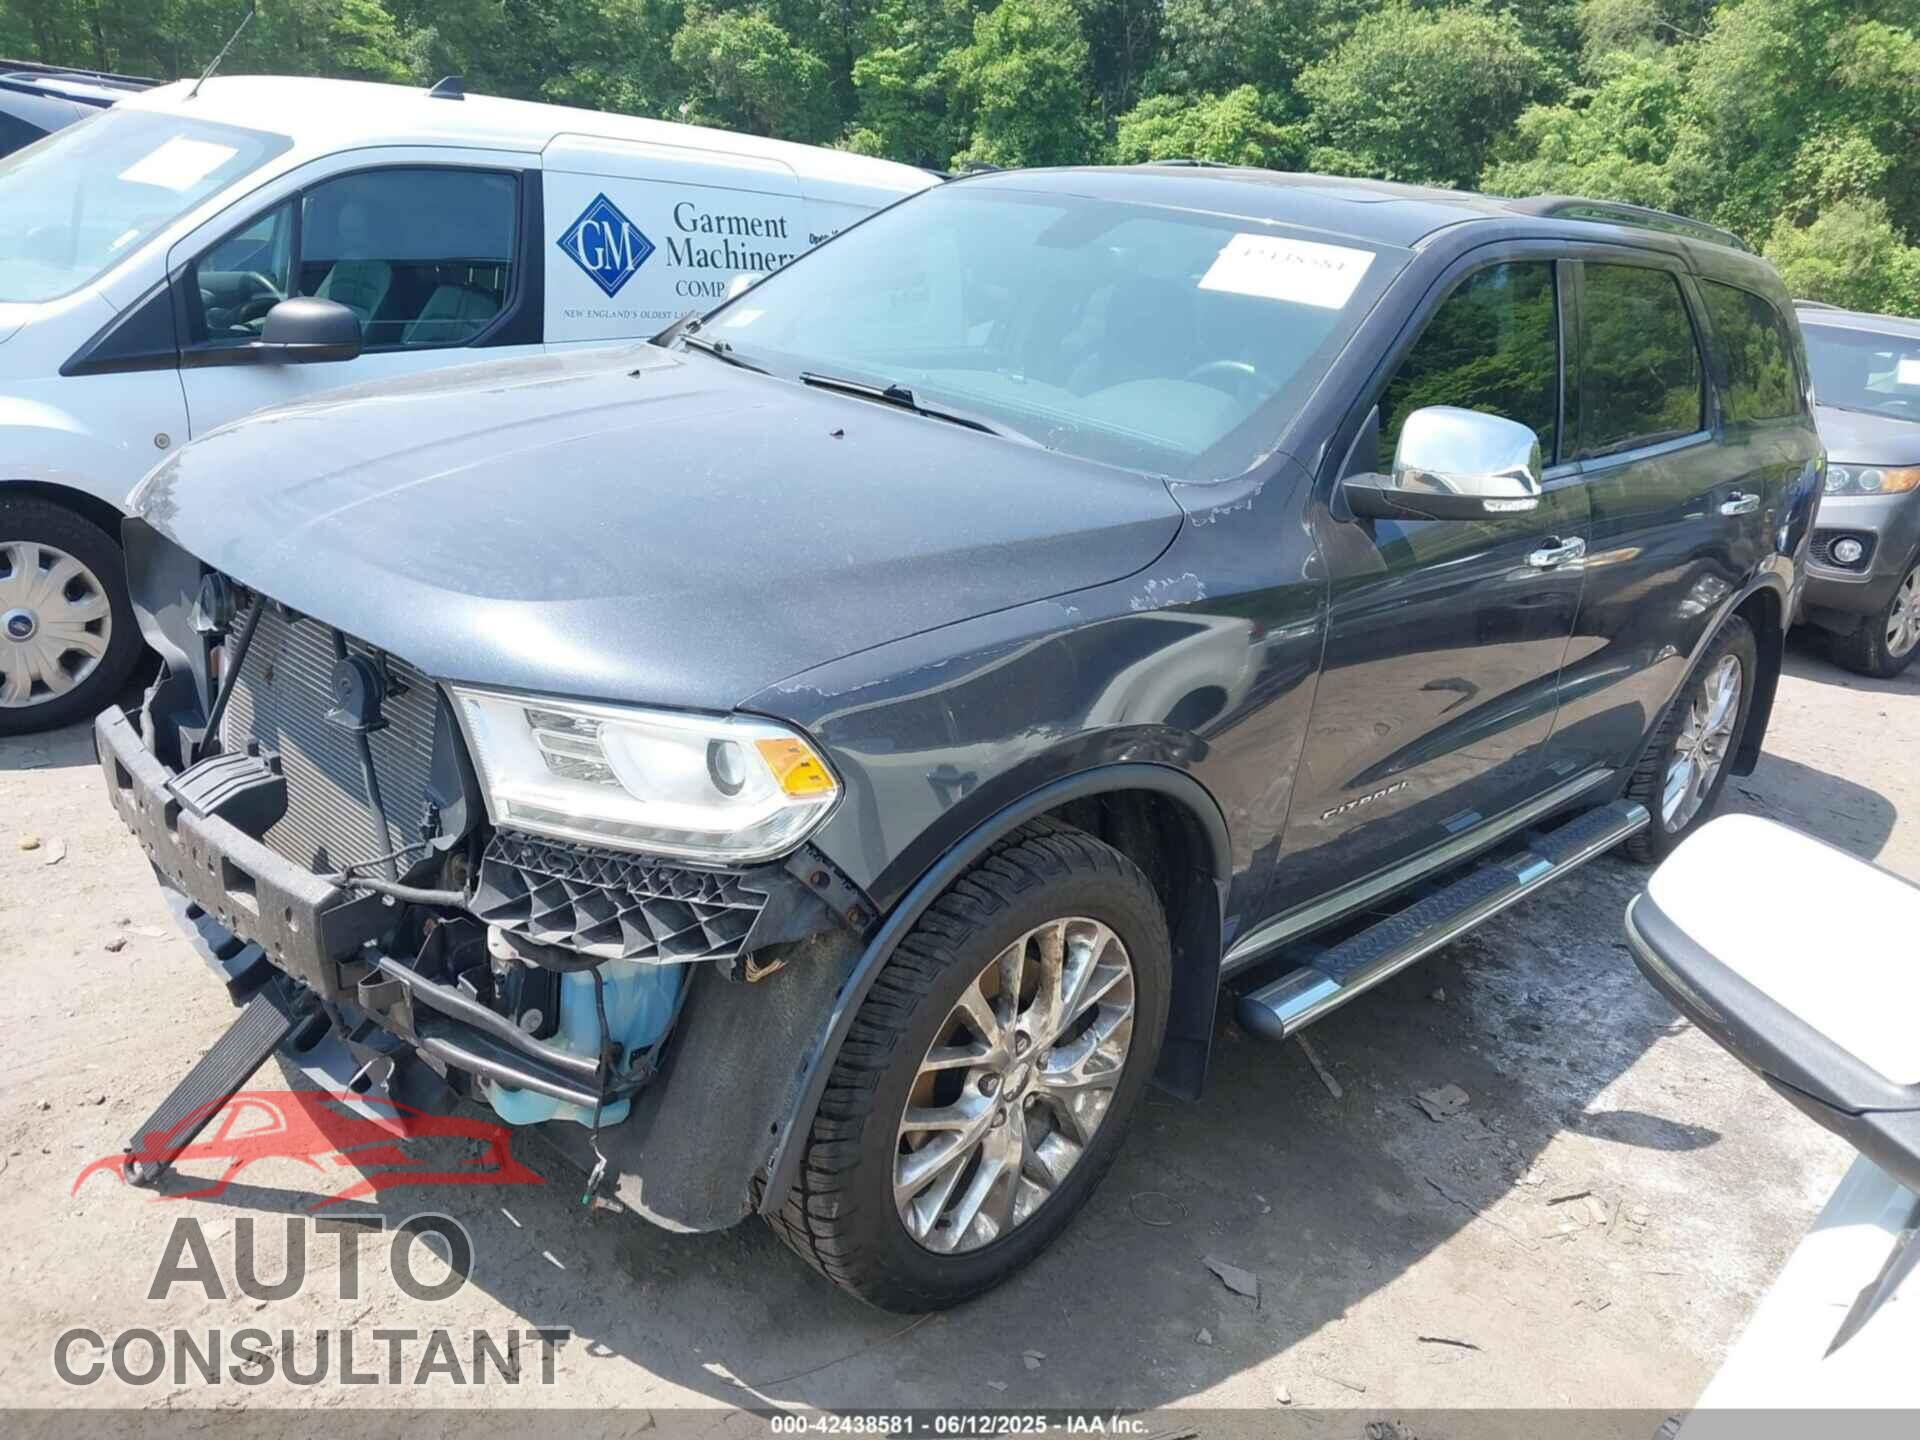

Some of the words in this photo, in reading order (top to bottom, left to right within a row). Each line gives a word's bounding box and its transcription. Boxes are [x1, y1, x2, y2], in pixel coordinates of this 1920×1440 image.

[673, 201, 788, 239] Garment
[577, 219, 635, 271] GM
[666, 236, 796, 272] Machiner
[564, 309, 583, 319] NEW
[587, 309, 638, 320] ENGLAND'S
[640, 311, 672, 320] OLDEST
